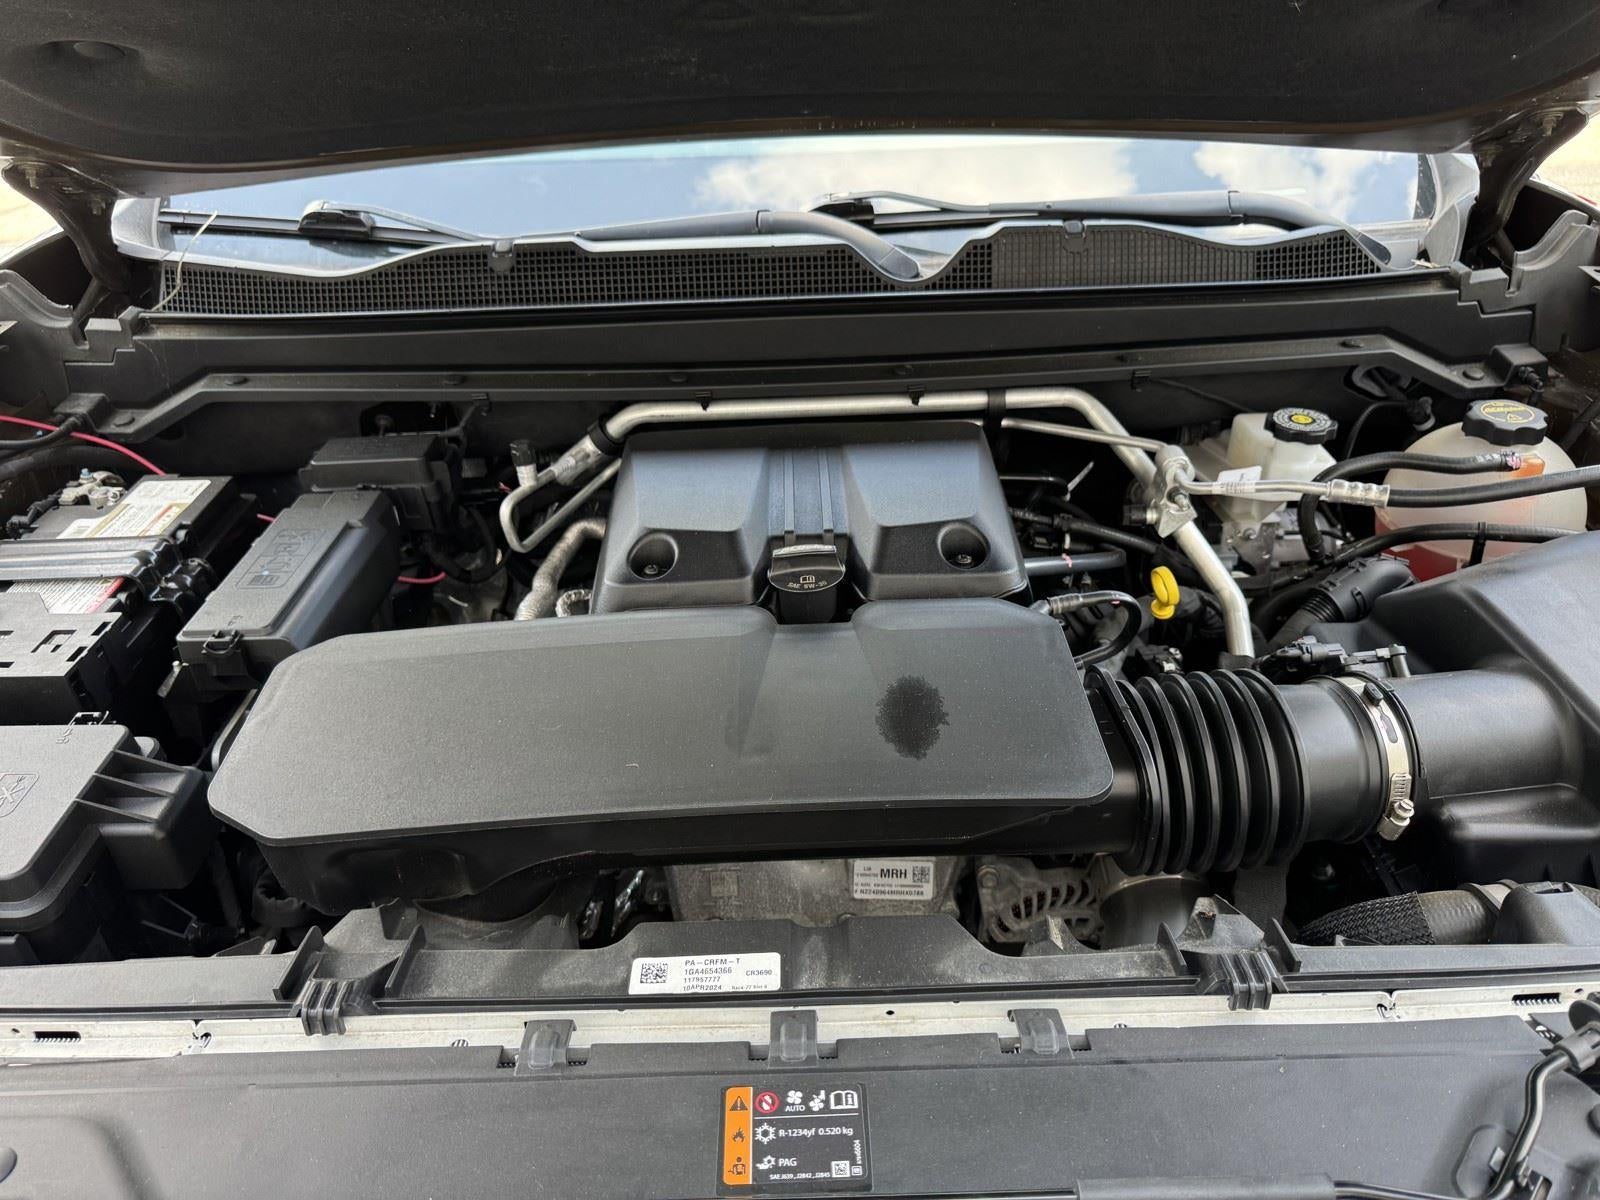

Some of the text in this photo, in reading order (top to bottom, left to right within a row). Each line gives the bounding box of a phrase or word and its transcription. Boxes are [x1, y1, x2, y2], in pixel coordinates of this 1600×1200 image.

[880, 868, 907, 879] MRH
[745, 969, 773, 977] CR3690
[683, 984, 722, 992] 10APR2024
[779, 1126, 854, 1138] R-1234yf 0.520 kg
[779, 1158, 797, 1167] PAG
